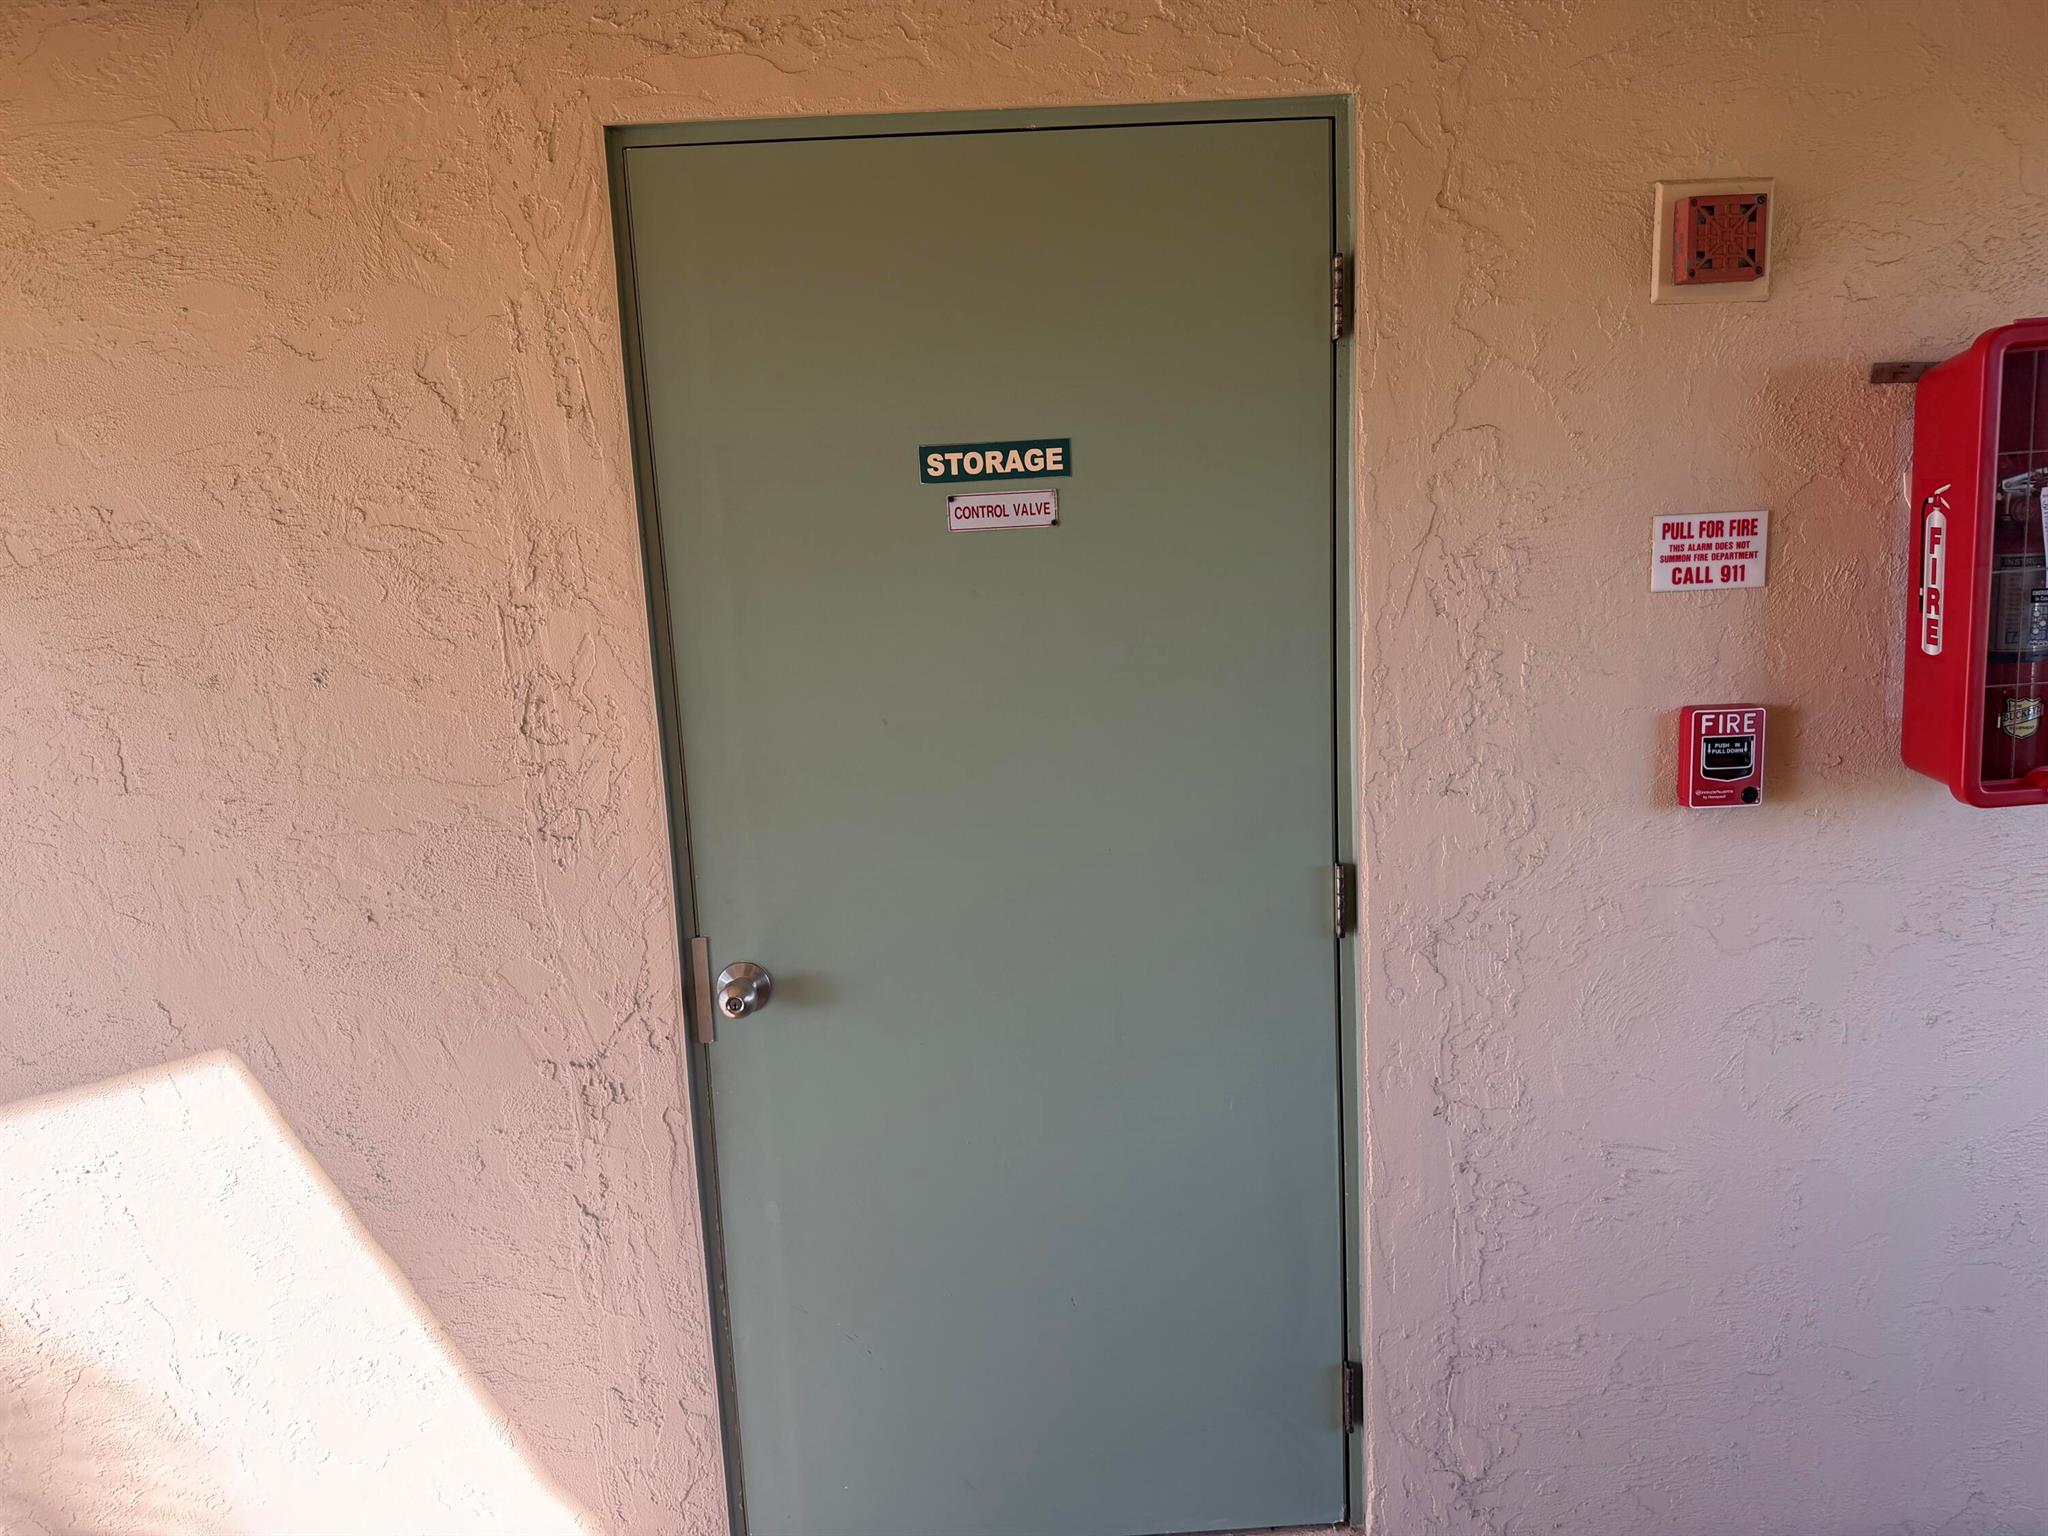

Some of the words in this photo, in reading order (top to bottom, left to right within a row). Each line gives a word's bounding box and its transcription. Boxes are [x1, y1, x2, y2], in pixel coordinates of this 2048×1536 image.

[927, 448, 1063, 477] STORAGE
[954, 504, 1009, 519] CONTROL
[1013, 502, 1051, 516] VALVE
[1662, 521, 1694, 540] PULL
[1698, 520, 1725, 538] FOR
[1729, 518, 1759, 537] FIRE
[1660, 554, 1691, 563] SUMMON
[1693, 553, 1709, 561] FIRE
[1711, 551, 1759, 560] DEPARTMENT
[1669, 544, 1685, 552] THIS
[1688, 543, 1712, 552] ALARM
[1715, 542, 1733, 550] DOES
[1736, 541, 1750, 549] NOT
[1671, 566, 1713, 585] CALL
[1720, 564, 1746, 583] 911
[1925, 526, 1942, 646] FIRE
[1701, 712, 1757, 735] FIRE
